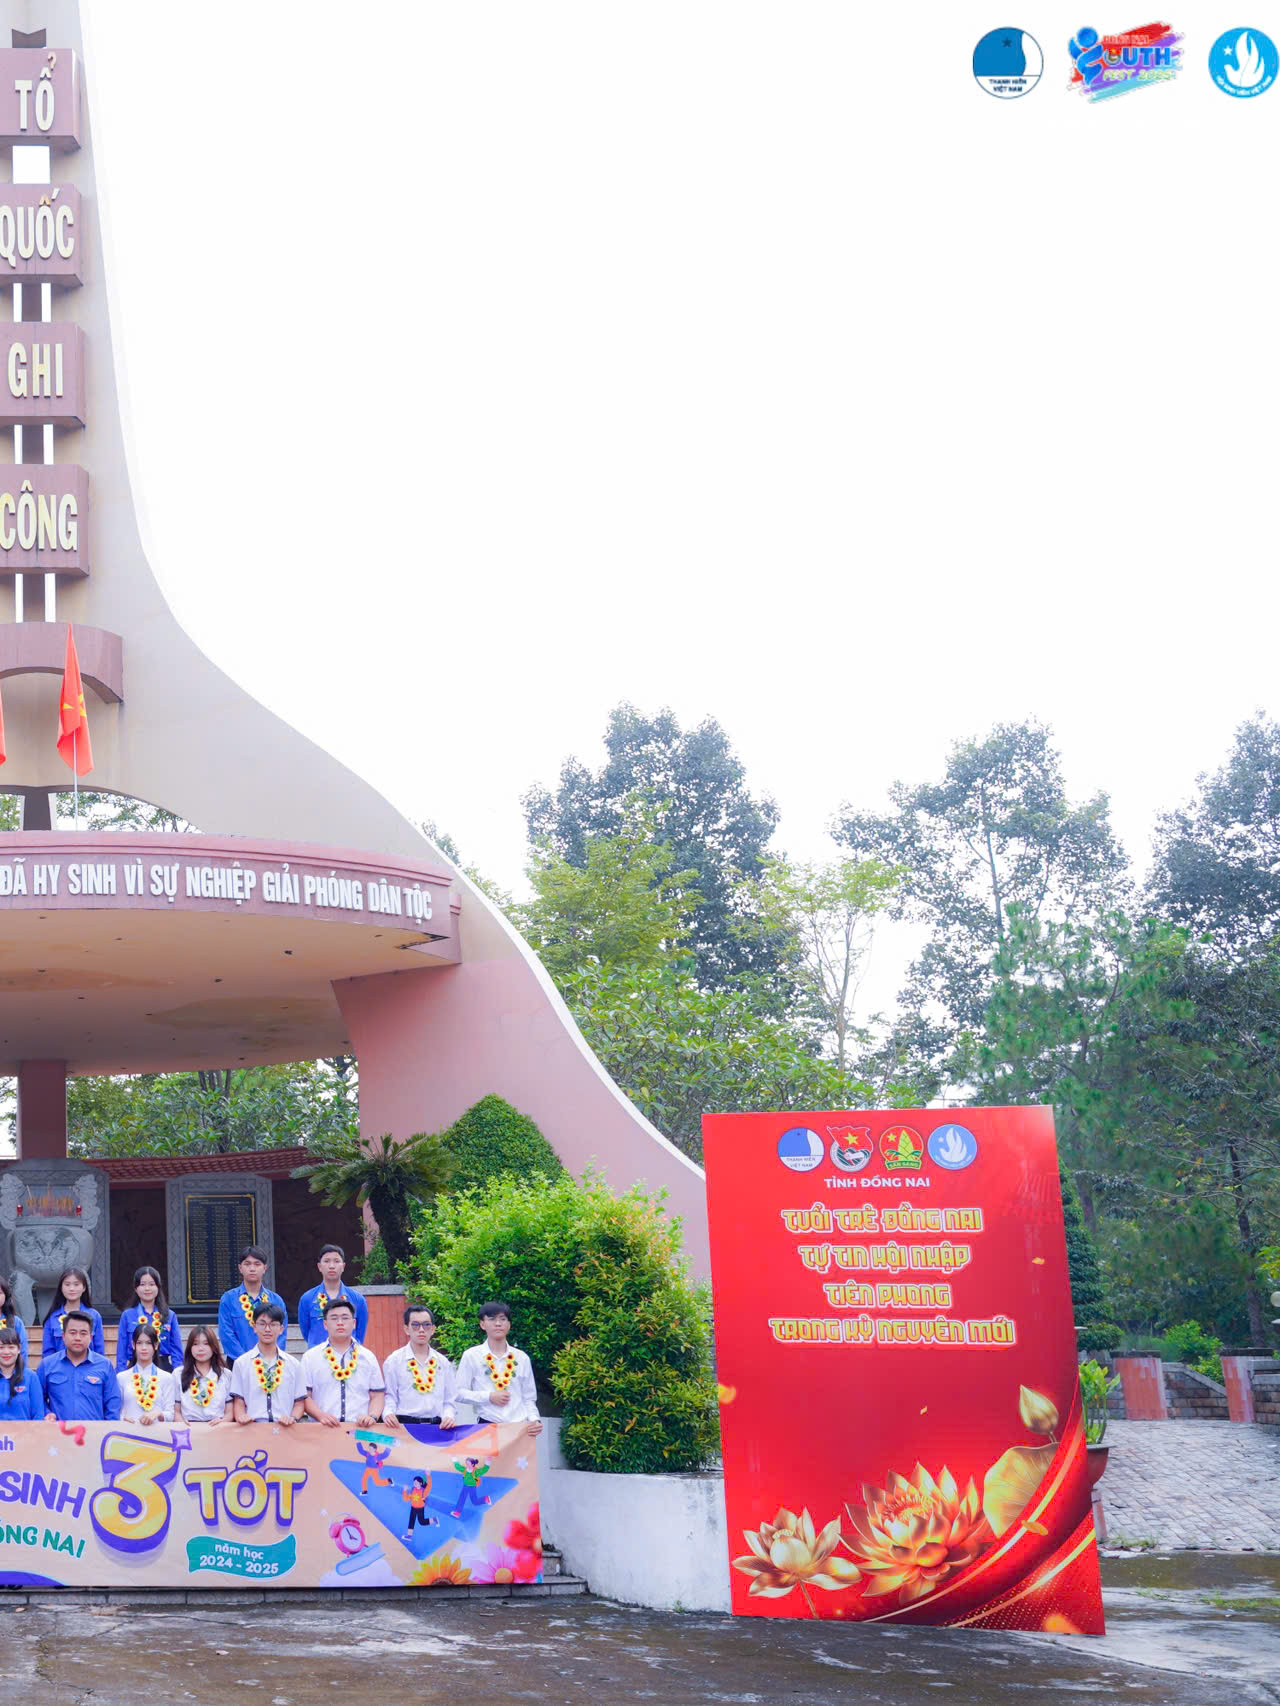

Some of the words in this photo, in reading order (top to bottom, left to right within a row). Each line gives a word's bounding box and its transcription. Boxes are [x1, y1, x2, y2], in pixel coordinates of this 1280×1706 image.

[14, 51, 57, 131] TỔ
[8, 342, 64, 399] GHI
[0, 857, 28, 896] ĐÃ
[33, 864, 61, 895] HY
[67, 863, 116, 895] SINH
[124, 857, 144, 895] VÌ
[150, 863, 180, 903] SỰ
[186, 861, 257, 905] NGHIỆP
[262, 863, 300, 904] GIẢI
[303, 871, 364, 911] PHÓNG
[367, 878, 402, 916] DÂN
[403, 883, 433, 925] TỘC
[781, 1202, 833, 1232] TUỔI
[833, 1205, 879, 1232] TRẺ
[881, 1202, 942, 1232] ĐỒNG
[943, 1208, 983, 1231] NAI
[799, 1244, 831, 1273] TỰ
[832, 1246, 870, 1269] TIN
[871, 1241, 908, 1273] HỘI
[910, 1241, 970, 1273] NHẬP
[824, 1280, 875, 1307] TIÊN
[876, 1284, 951, 1308] PHONG
[770, 1319, 842, 1342] TRONG
[843, 1315, 875, 1342] KỶ
[877, 1316, 965, 1343] NGUYÊN
[967, 1316, 1017, 1344] MỚI
[89, 1431, 180, 1553] 3
[183, 1449, 308, 1527] TỐT
[42, 1528, 86, 1558] NAI
[215, 1543, 240, 1556] năm
[243, 1548, 264, 1563] học
[199, 1555, 234, 1569] 2024
[245, 1561, 279, 1575] 2025
